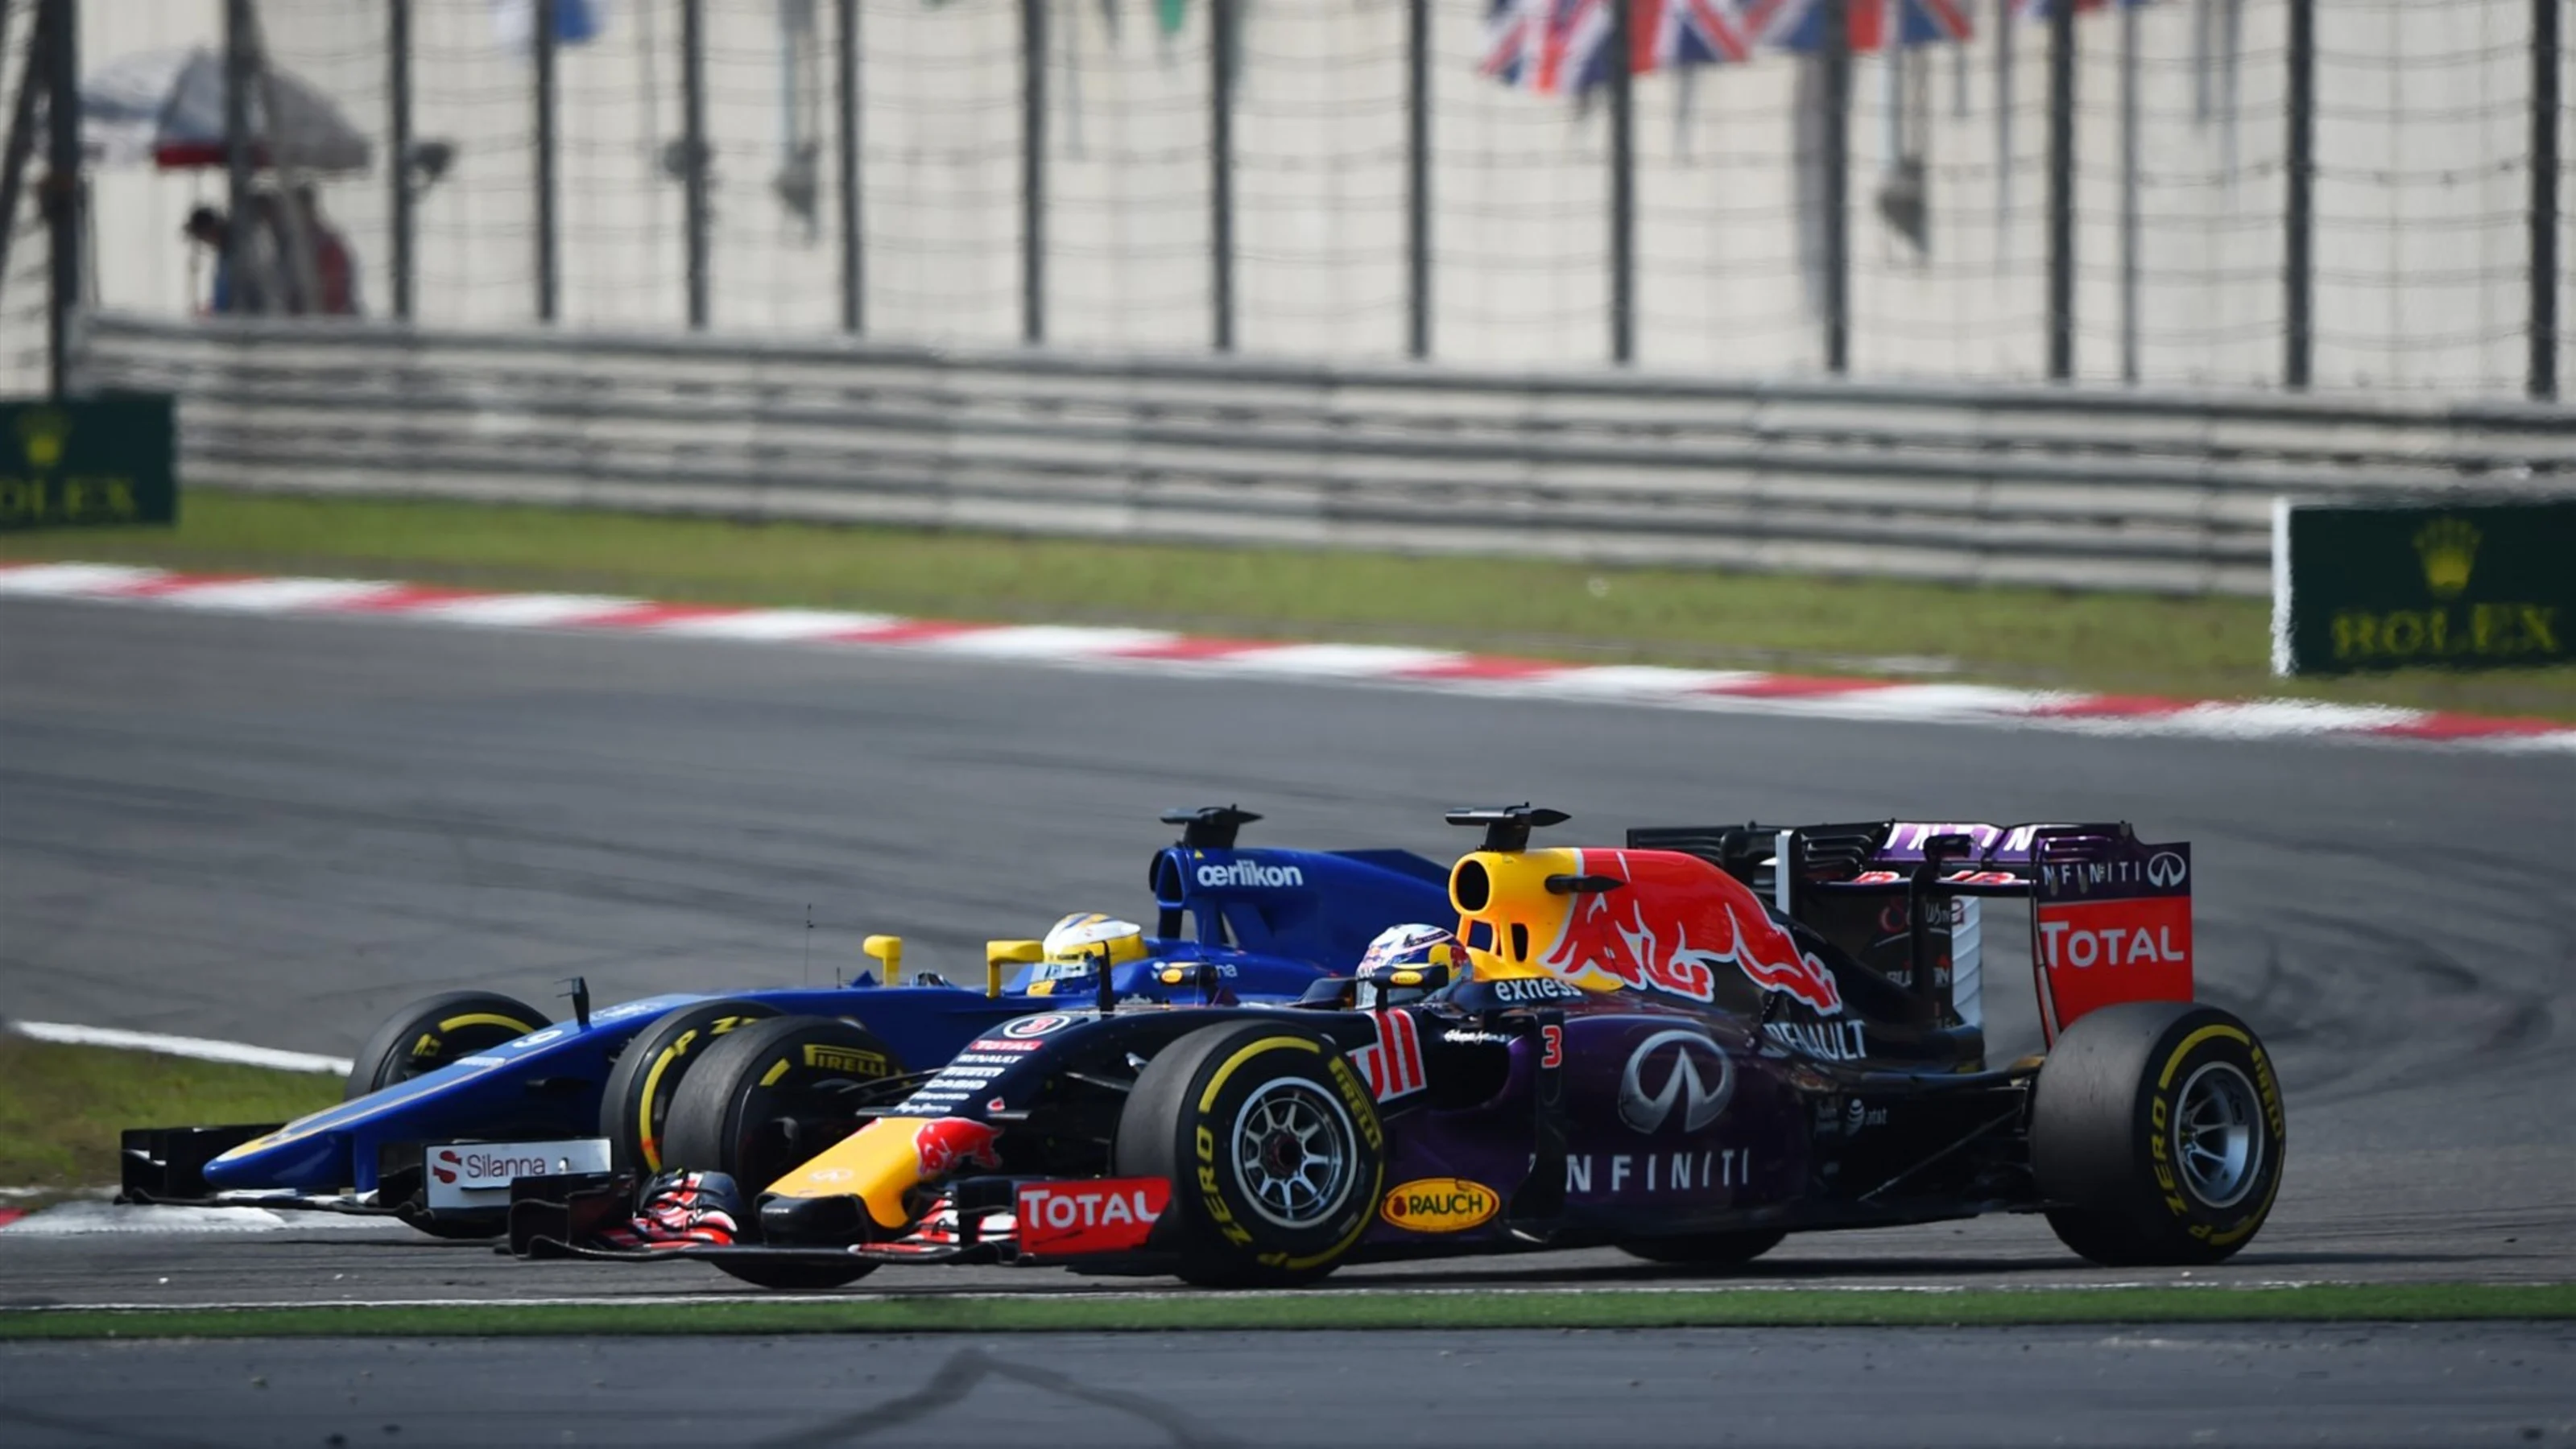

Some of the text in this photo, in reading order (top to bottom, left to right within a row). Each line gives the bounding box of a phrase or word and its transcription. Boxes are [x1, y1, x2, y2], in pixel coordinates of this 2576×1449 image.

[0, 475, 137, 520] OLEX
[2332, 605, 2559, 657] ROLEX
[2043, 861, 2140, 886] NFINITI
[2039, 921, 2185, 969] TOTAL
[1495, 977, 1583, 1001] exness
[803, 1044, 886, 1077] PIRELLI
[974, 1040, 1036, 1051] TOTAL
[1540, 1024, 1563, 1069] 3
[1328, 1055, 1383, 1151] PIRELLI
[466, 1154, 546, 1179] Silanna
[1528, 1147, 1749, 1193] NFINITI
[2151, 1094, 2189, 1216] ZERO
[1196, 1124, 1253, 1248] ZERO
[1408, 1193, 1482, 1215] RAUCH
[1019, 1190, 1161, 1229] TOTAL
